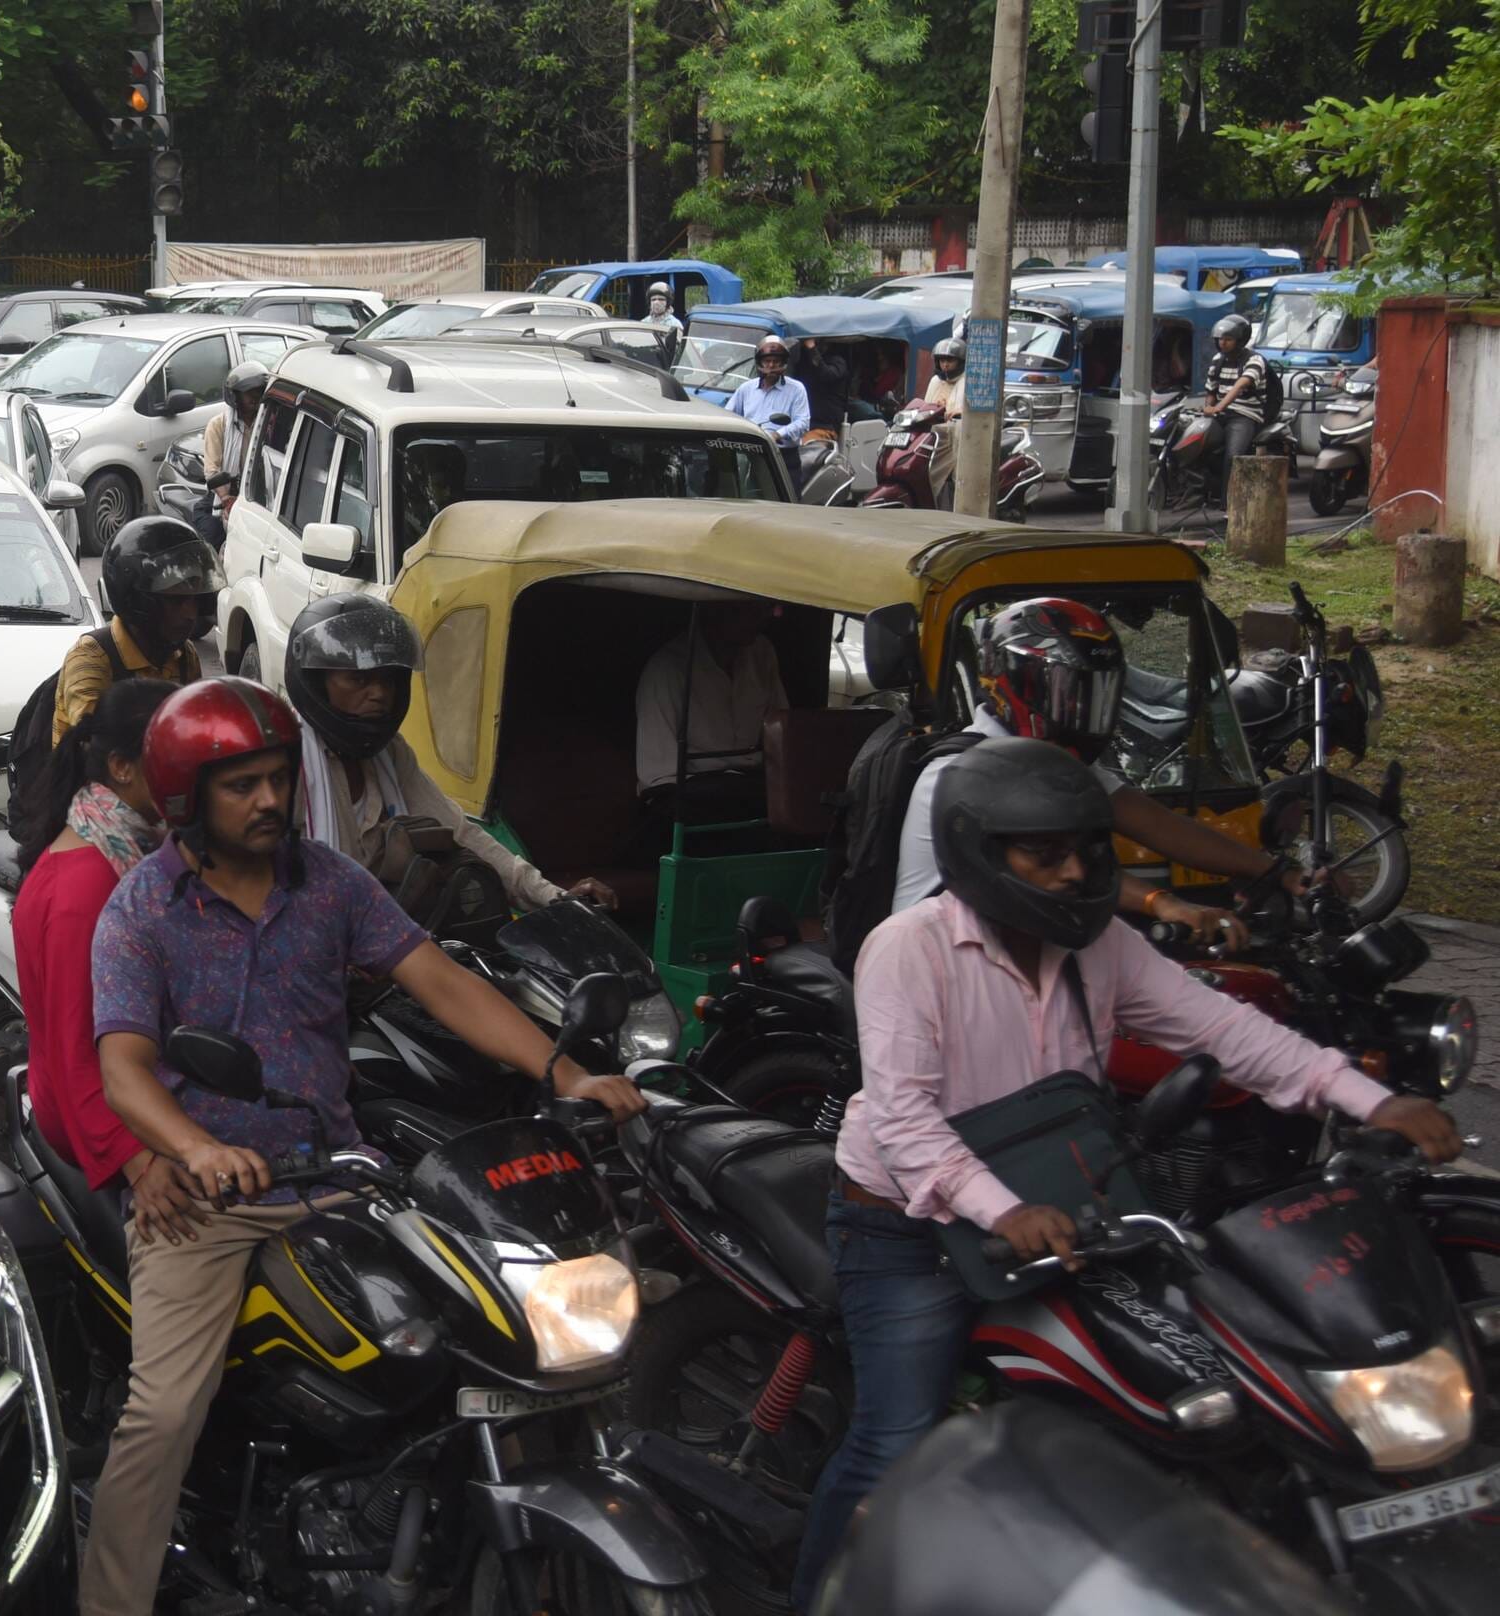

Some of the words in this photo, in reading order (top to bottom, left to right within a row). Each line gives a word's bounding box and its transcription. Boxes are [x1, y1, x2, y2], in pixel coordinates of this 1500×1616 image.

[320, 255, 368, 276] VICTORIOUS
[371, 254, 388, 274] YOU
[388, 252, 409, 273] WILL
[410, 250, 437, 273] ENJOY
[705, 438, 764, 453] अधिवक्ता
[485, 1151, 582, 1190] MEDIA
[487, 1393, 514, 1414] UP
